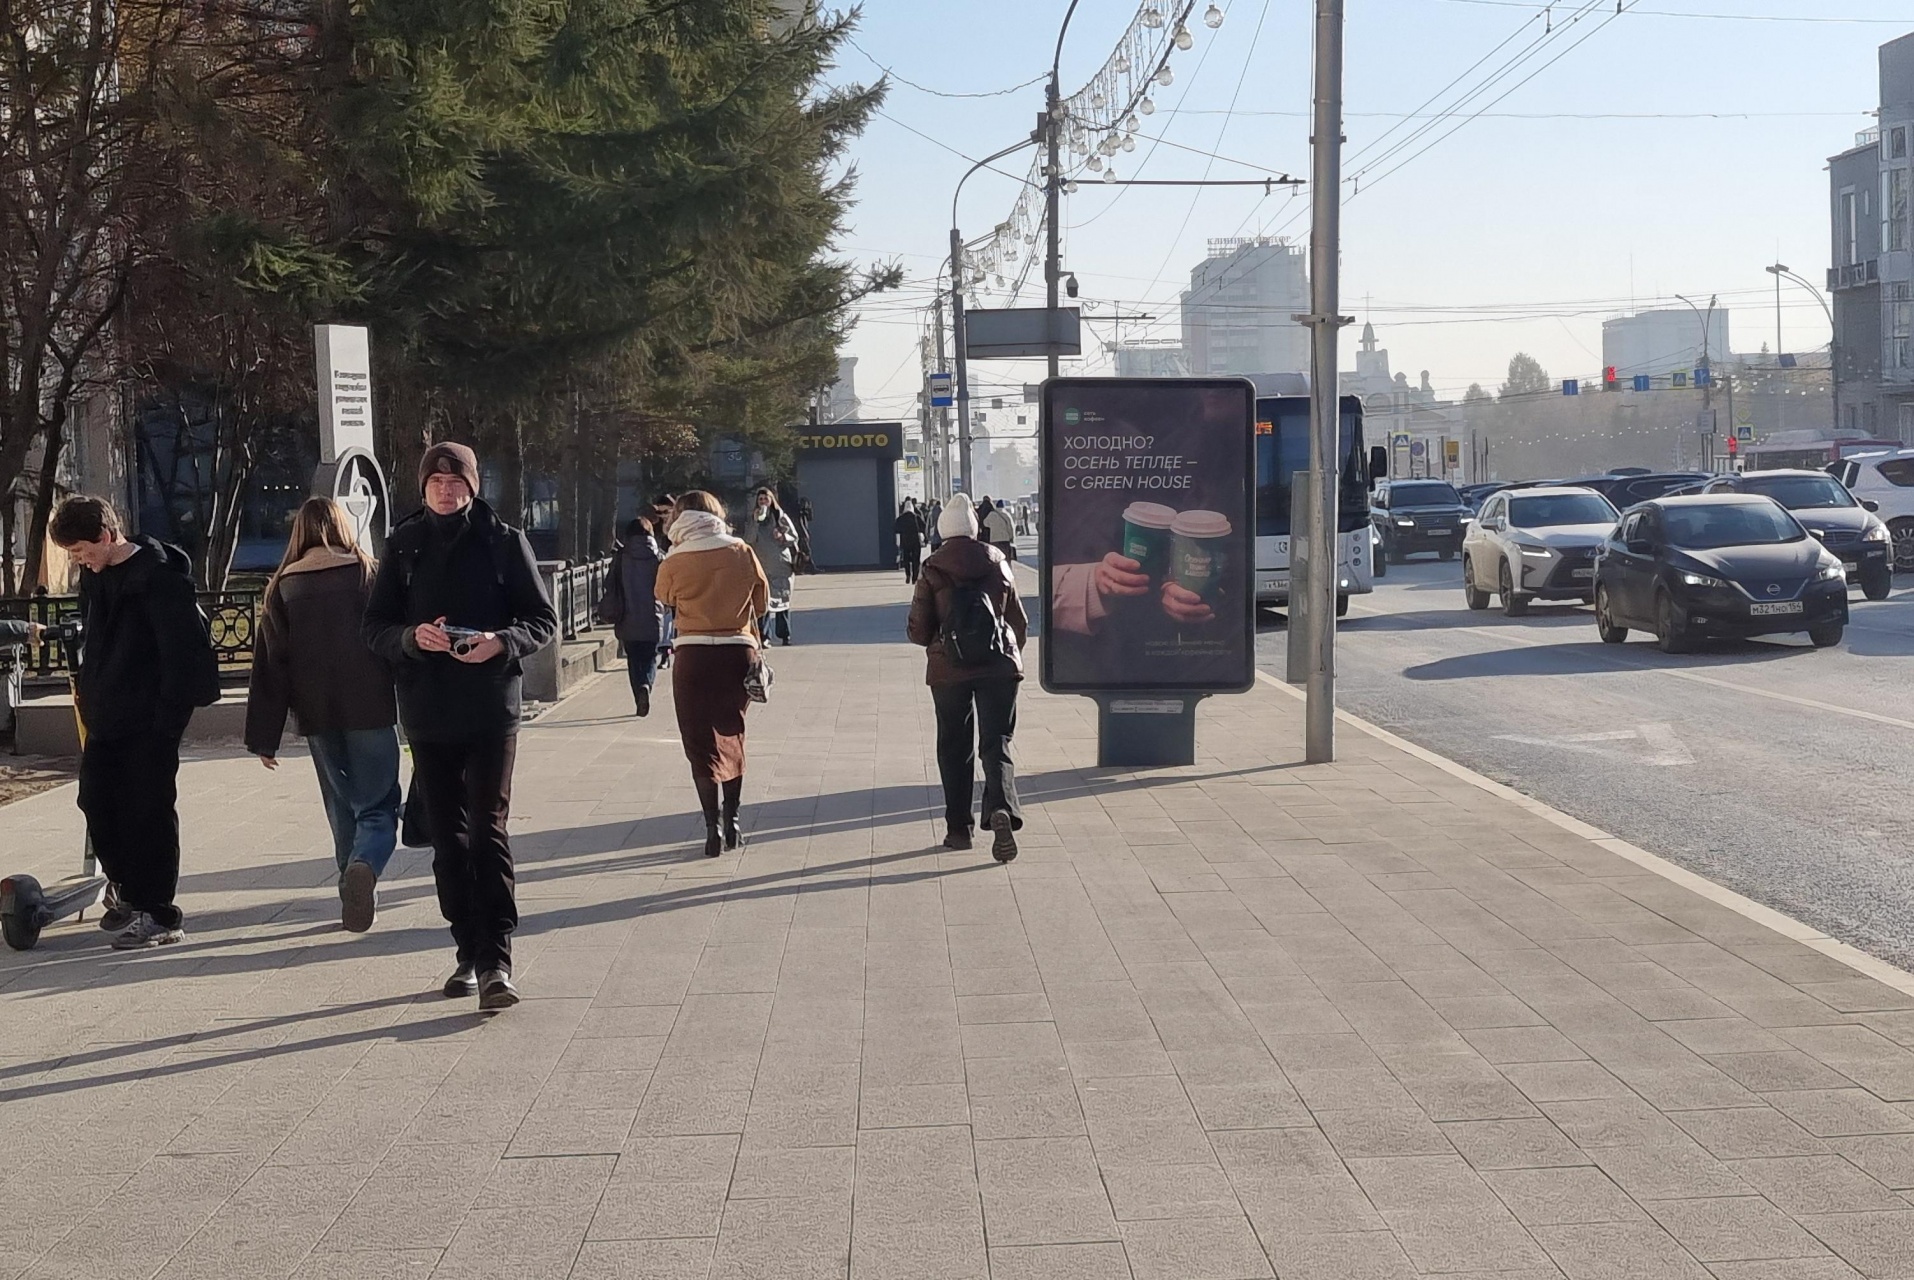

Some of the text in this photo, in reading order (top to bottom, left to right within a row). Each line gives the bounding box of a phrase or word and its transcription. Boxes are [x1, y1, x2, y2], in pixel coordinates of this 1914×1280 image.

[799, 433, 889, 449] СТОЛОТО
[1064, 435, 1155, 451] ХОЛОДНО?
[1064, 456, 1120, 470] ОСЕНЬ
[1125, 455, 1183, 470] ТЕПЛЕЕ
[1081, 475, 1134, 490] GREEN
[1137, 474, 1192, 490] HOUSE
